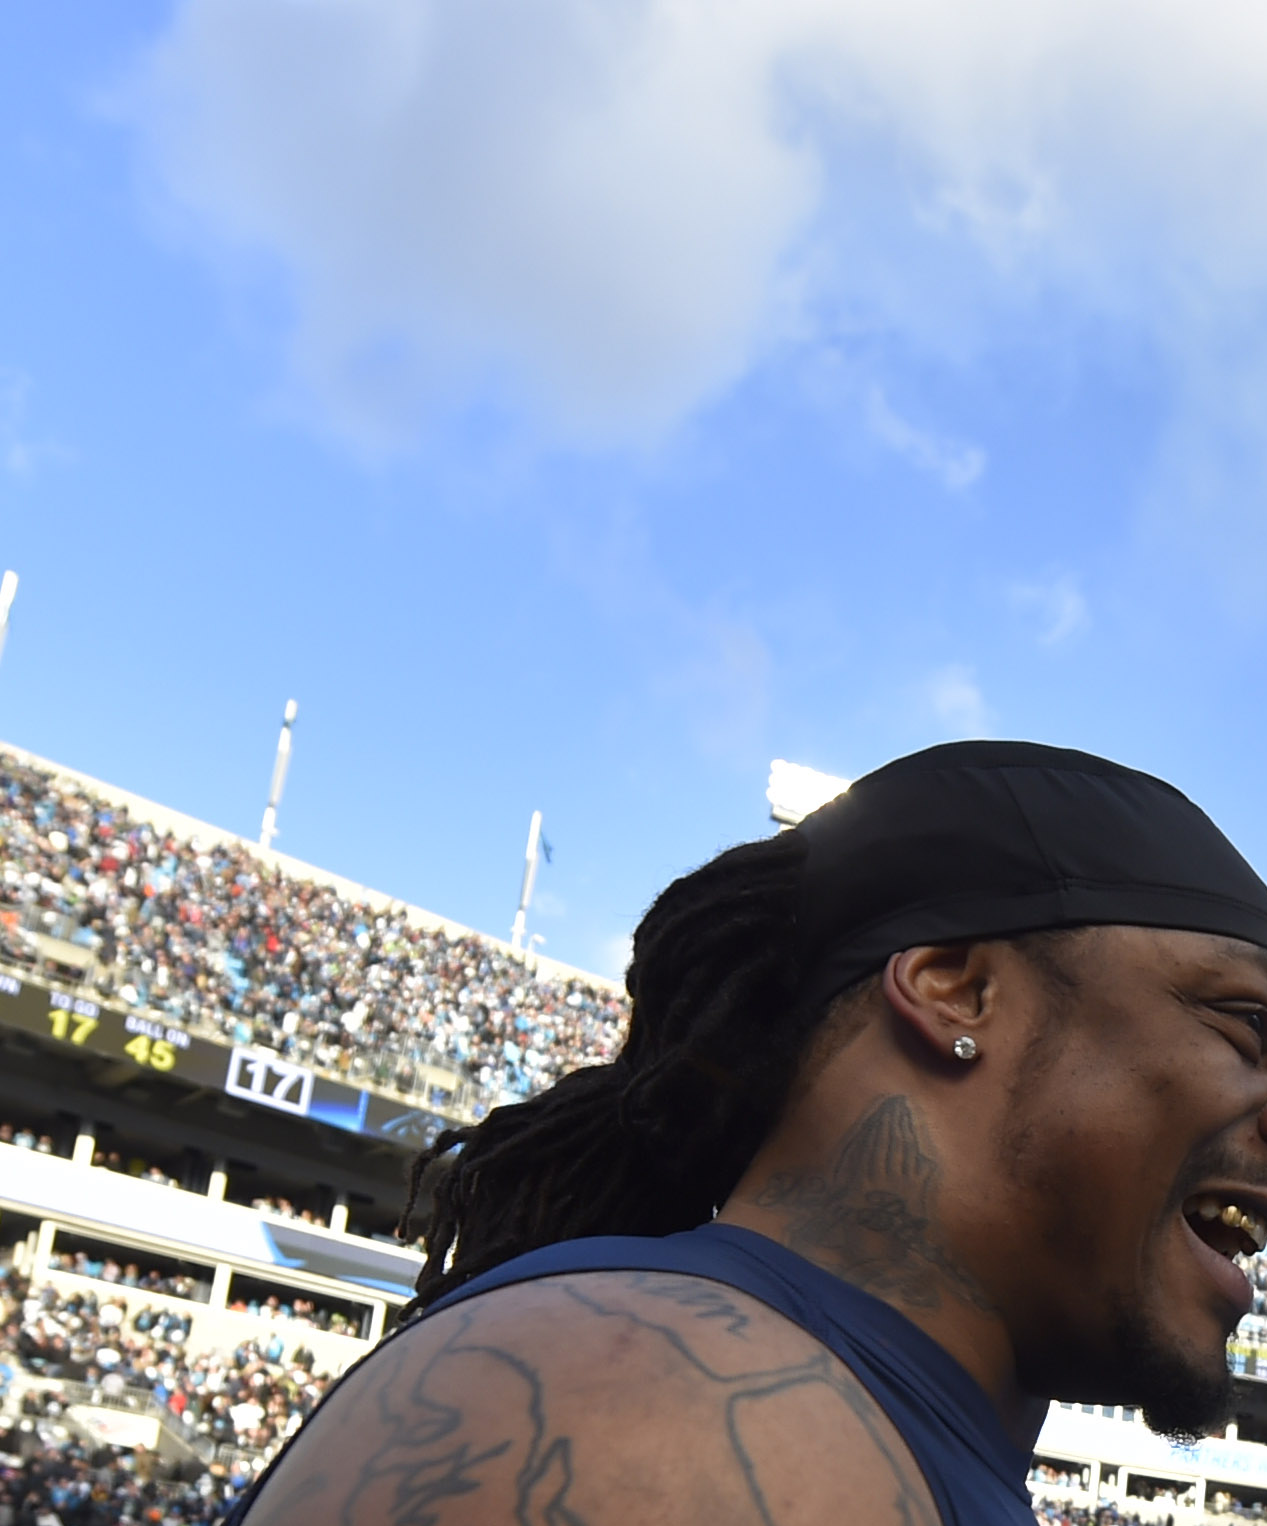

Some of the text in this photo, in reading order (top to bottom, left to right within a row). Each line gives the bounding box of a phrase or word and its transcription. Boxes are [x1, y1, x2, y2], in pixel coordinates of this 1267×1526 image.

[48, 1009, 99, 1045] 17
[125, 1016, 192, 1049] BALL ON
[124, 1034, 177, 1072] 45
[245, 1060, 301, 1101] 17
